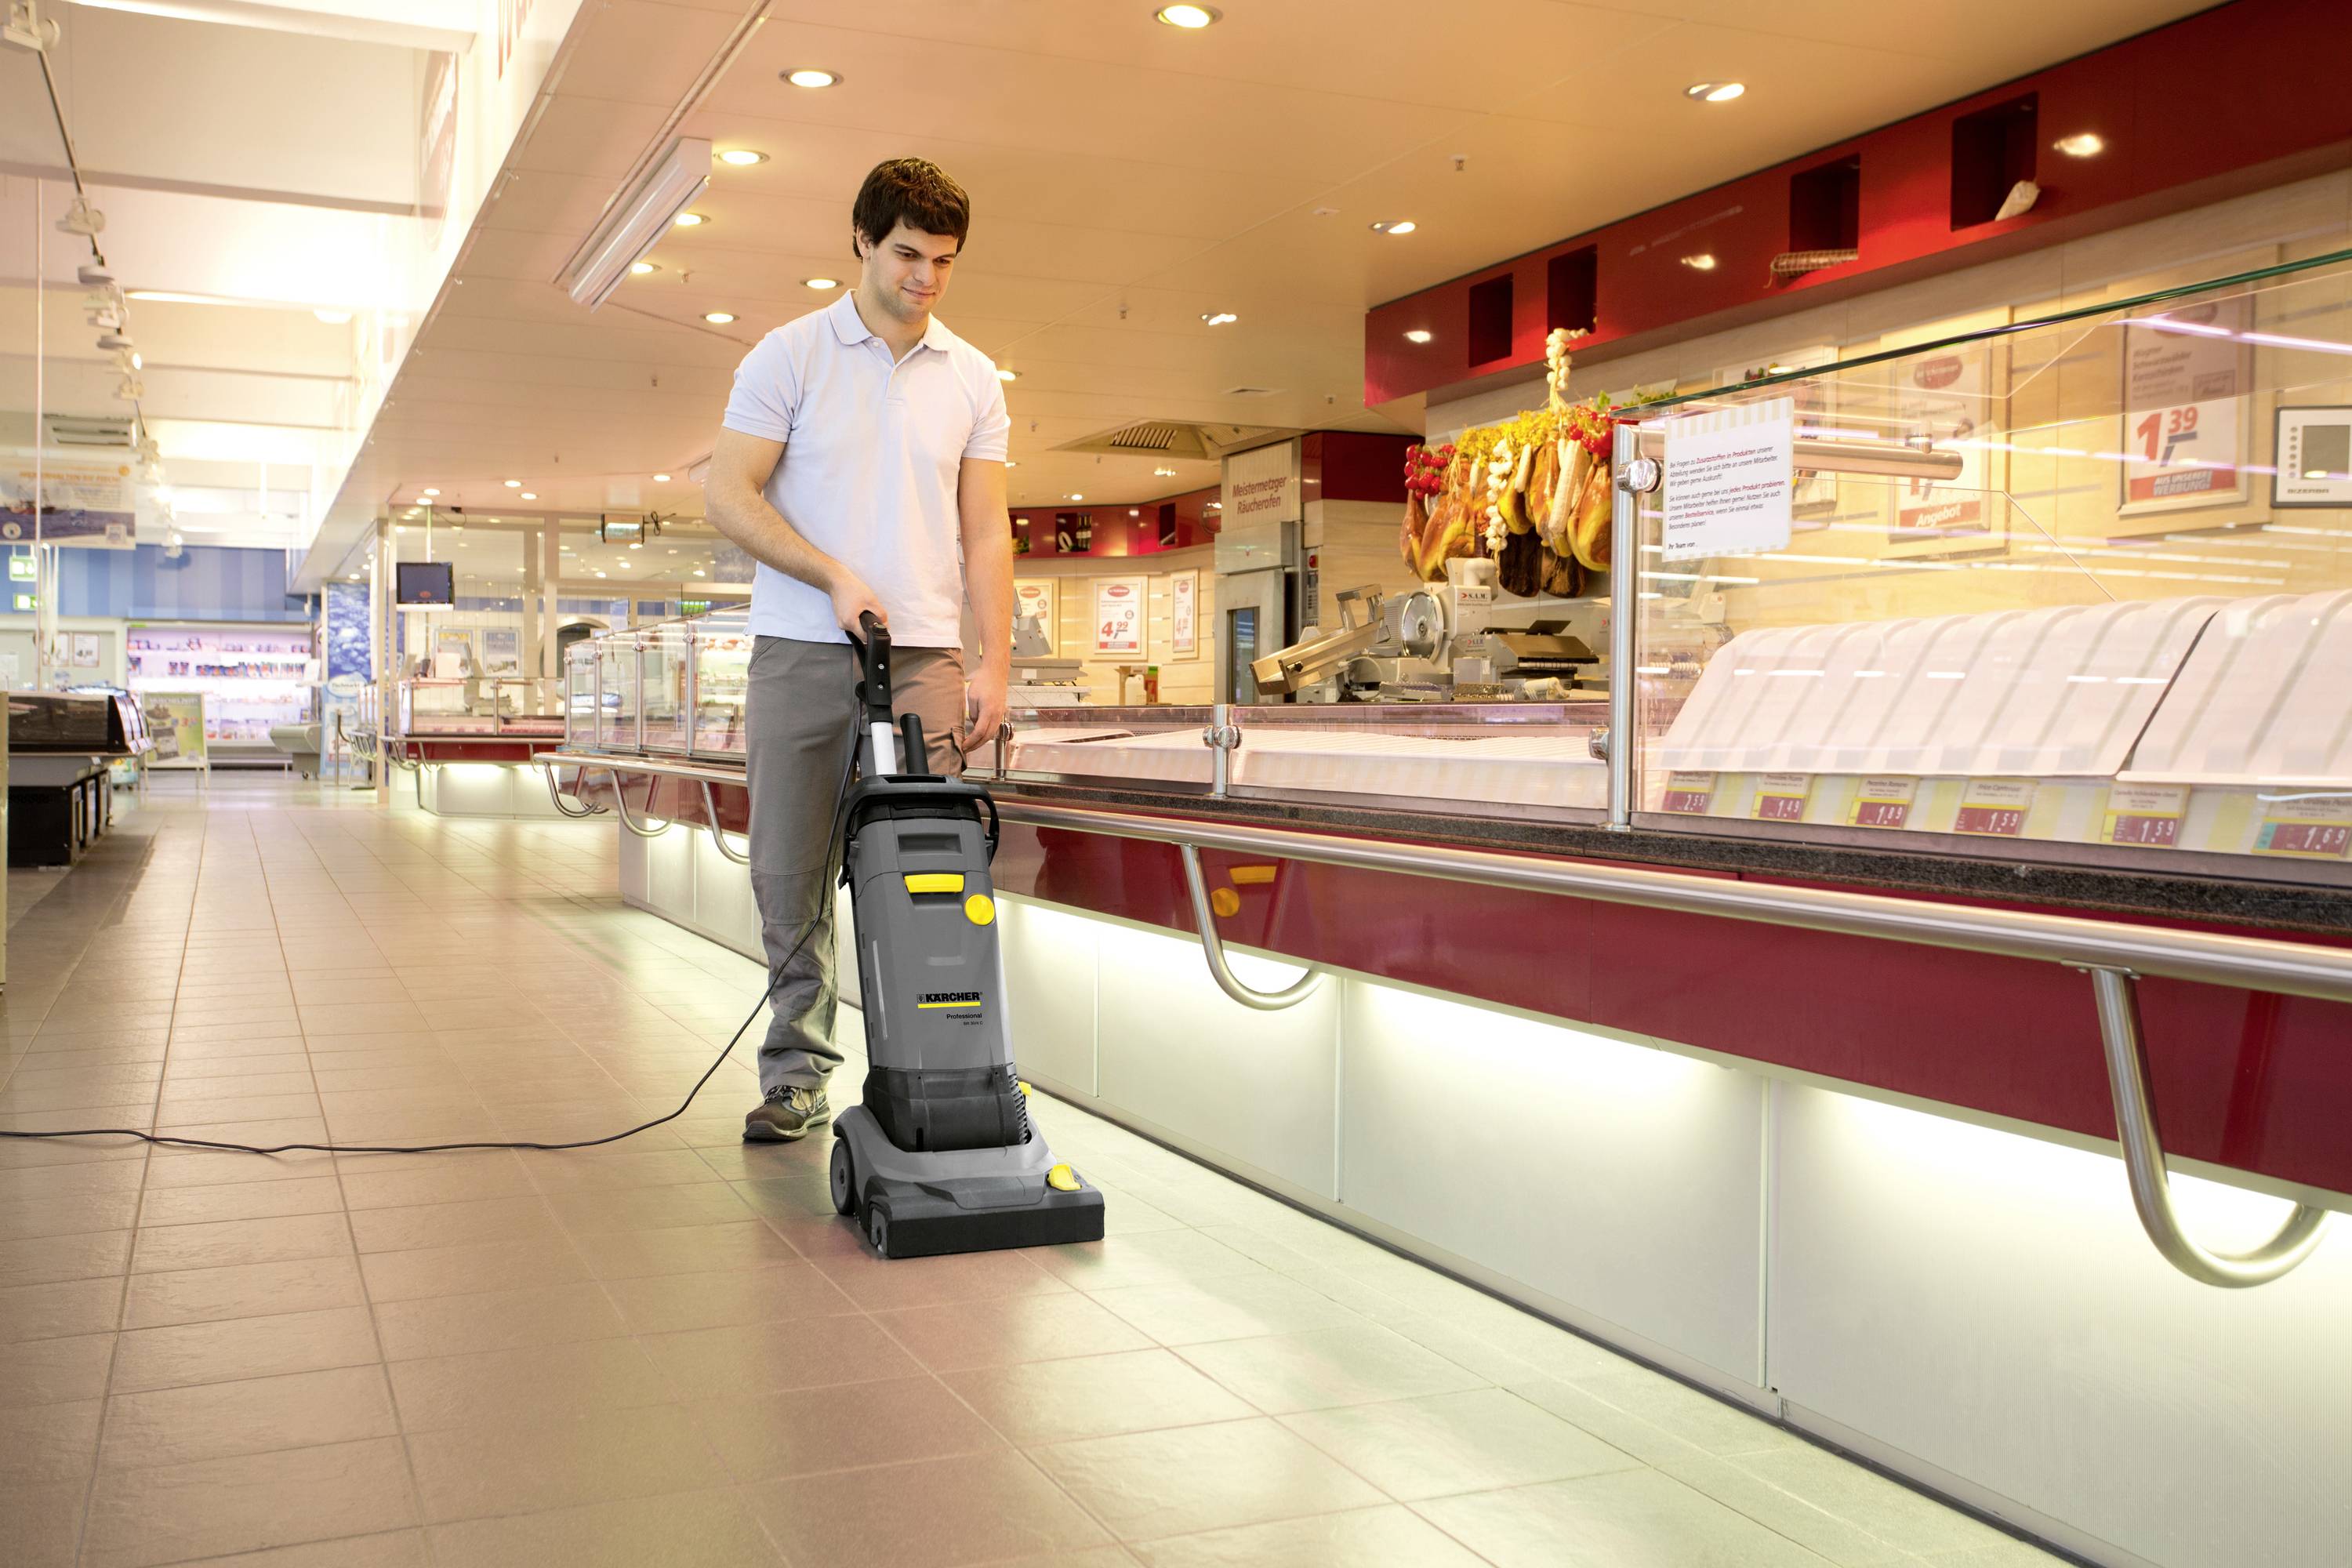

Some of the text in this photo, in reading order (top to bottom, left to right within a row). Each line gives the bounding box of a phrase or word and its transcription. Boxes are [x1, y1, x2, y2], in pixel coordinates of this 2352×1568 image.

[1696, 454, 1726, 464] Zusatzstoffen
[1732, 448, 1756, 457] Produkten
[1232, 476, 1287, 497] Meistermetzger
[1677, 478, 1690, 488] geben
[1690, 477, 1701, 485] gerne
[1729, 486, 1741, 495] jedes
[1742, 483, 1761, 492] Produkt
[1237, 494, 1281, 514] Räucherofen
[1683, 501, 1705, 510] Mitarbeiter
[1916, 505, 1962, 527] Angebot
[1876, 805, 1903, 826] 1.89
[1988, 811, 2019, 833] 1.59
[2140, 820, 2175, 843] 1.59
[2304, 826, 2347, 850] 1.69
[926, 992, 980, 1002] KÄRCHER
